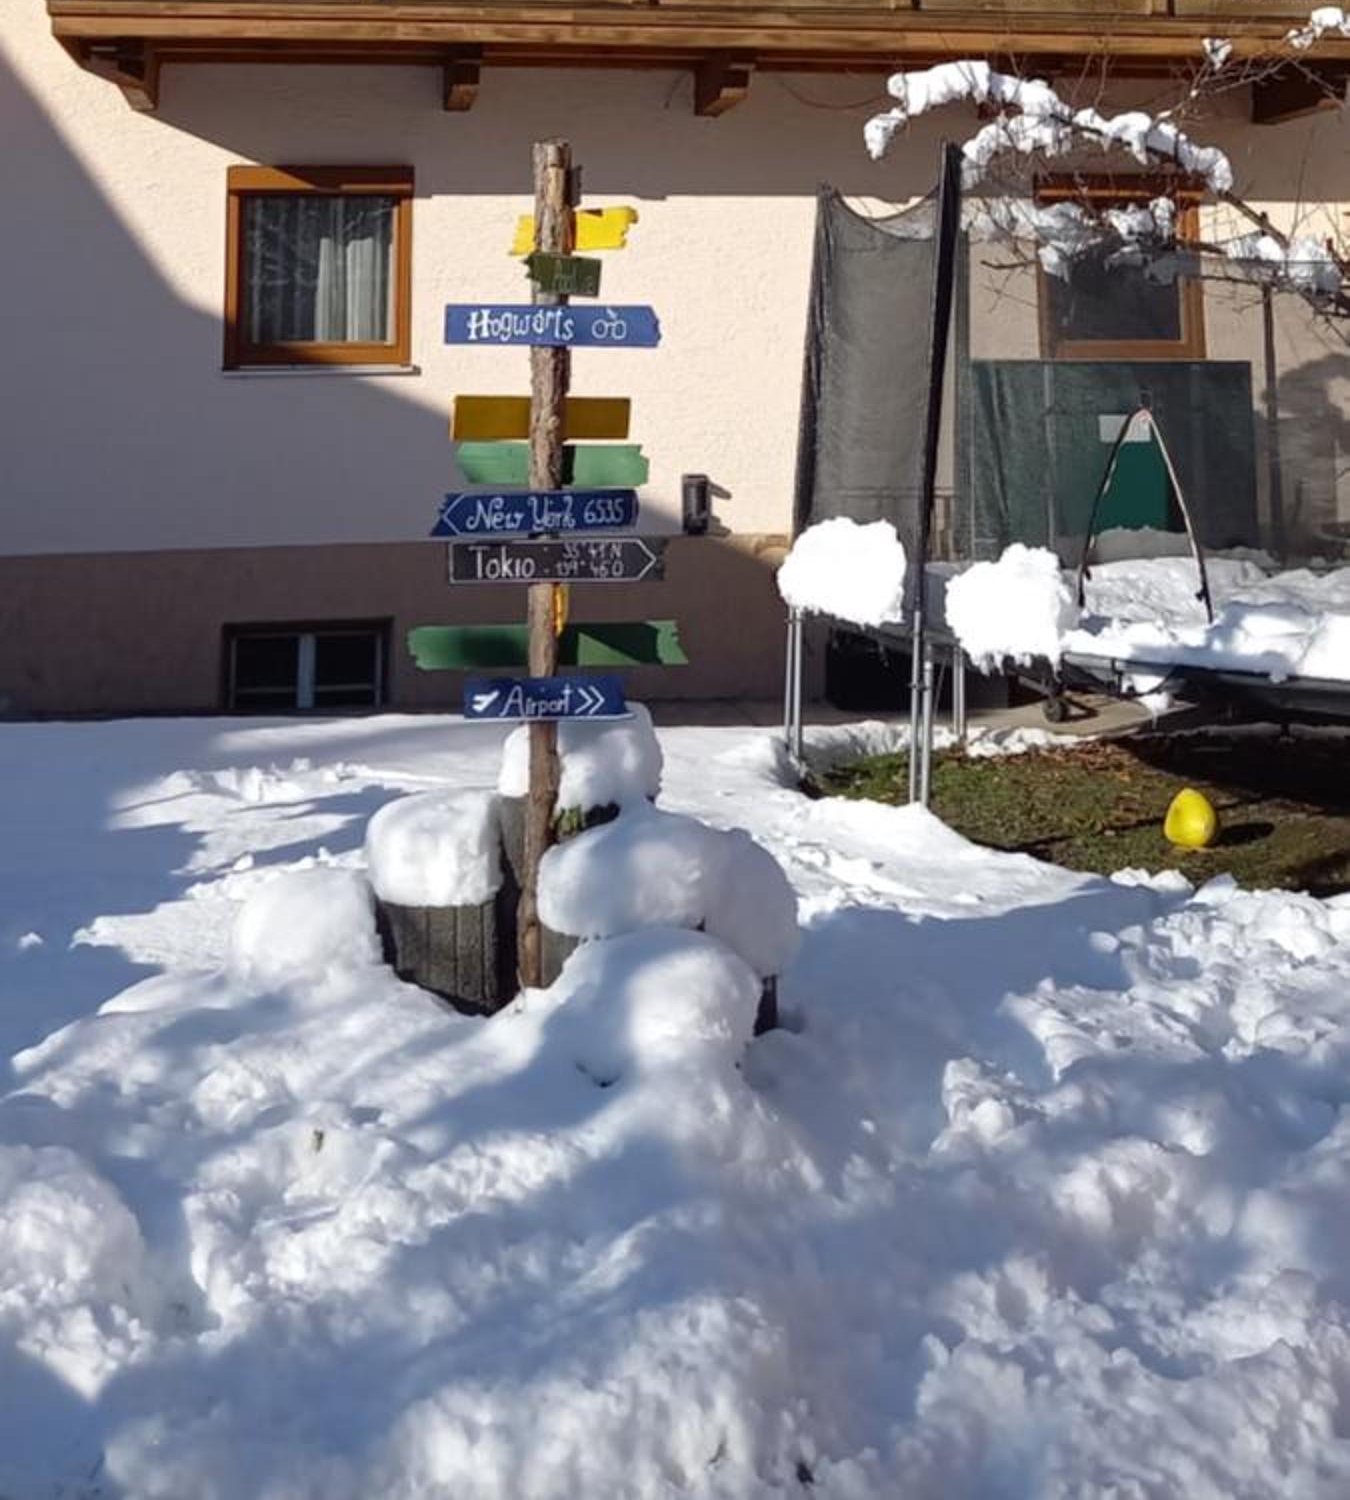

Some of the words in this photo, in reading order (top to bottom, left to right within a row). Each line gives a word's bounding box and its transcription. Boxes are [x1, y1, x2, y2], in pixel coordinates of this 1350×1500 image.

[467, 307, 575, 342] Hogwarts
[465, 497, 525, 531] New
[527, 494, 577, 532] York
[583, 498, 625, 524] 6535
[500, 683, 571, 718] Airport
